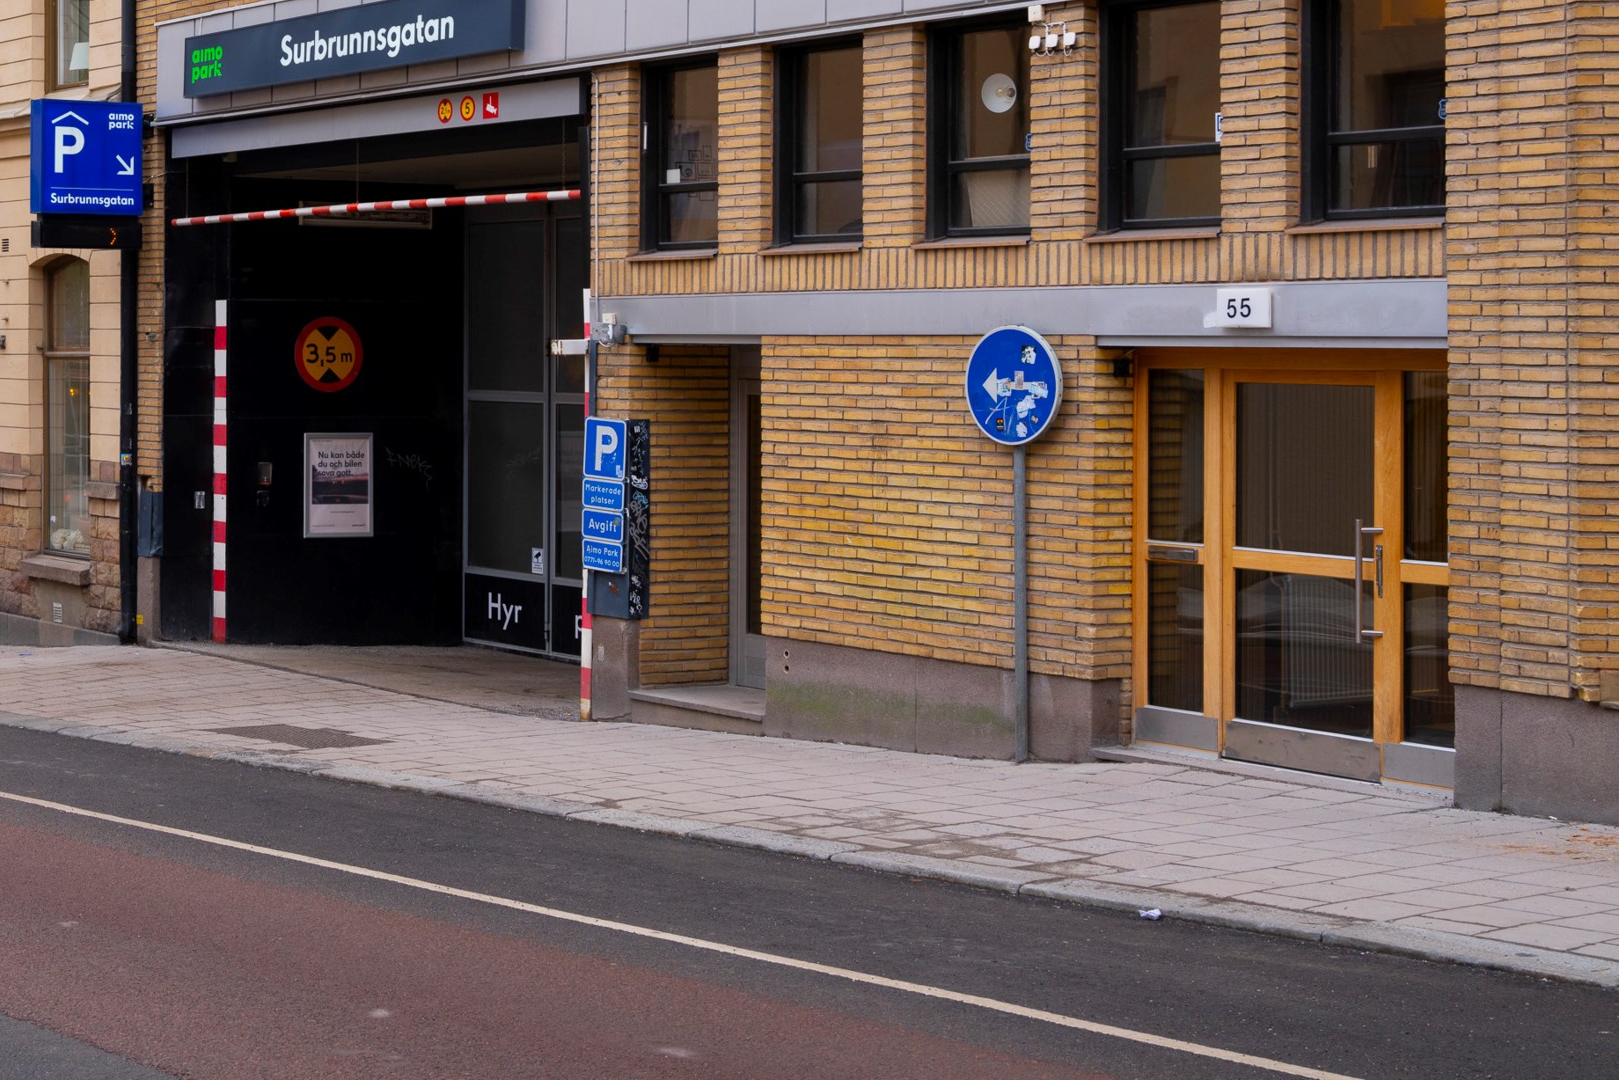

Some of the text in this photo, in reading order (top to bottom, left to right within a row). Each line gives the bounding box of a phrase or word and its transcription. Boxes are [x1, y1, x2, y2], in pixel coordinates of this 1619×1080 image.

[280, 15, 454, 66] Surbrunnsgatan
[192, 46, 223, 63] aimo
[192, 64, 222, 83] park
[465, 102, 470, 115] 5
[109, 121, 134, 130] park
[54, 126, 85, 173] P
[51, 193, 134, 207] Surbrunnsgatan
[1227, 298, 1251, 318] 55
[306, 343, 353, 367] 3,5 m
[318, 451, 365, 459] Nu kan både
[595, 425, 618, 471] P
[585, 484, 621, 495] Markerade
[591, 496, 615, 504] platser
[588, 518, 617, 533] Avgift
[604, 548, 618, 557] Park
[488, 592, 522, 630] Hyr
